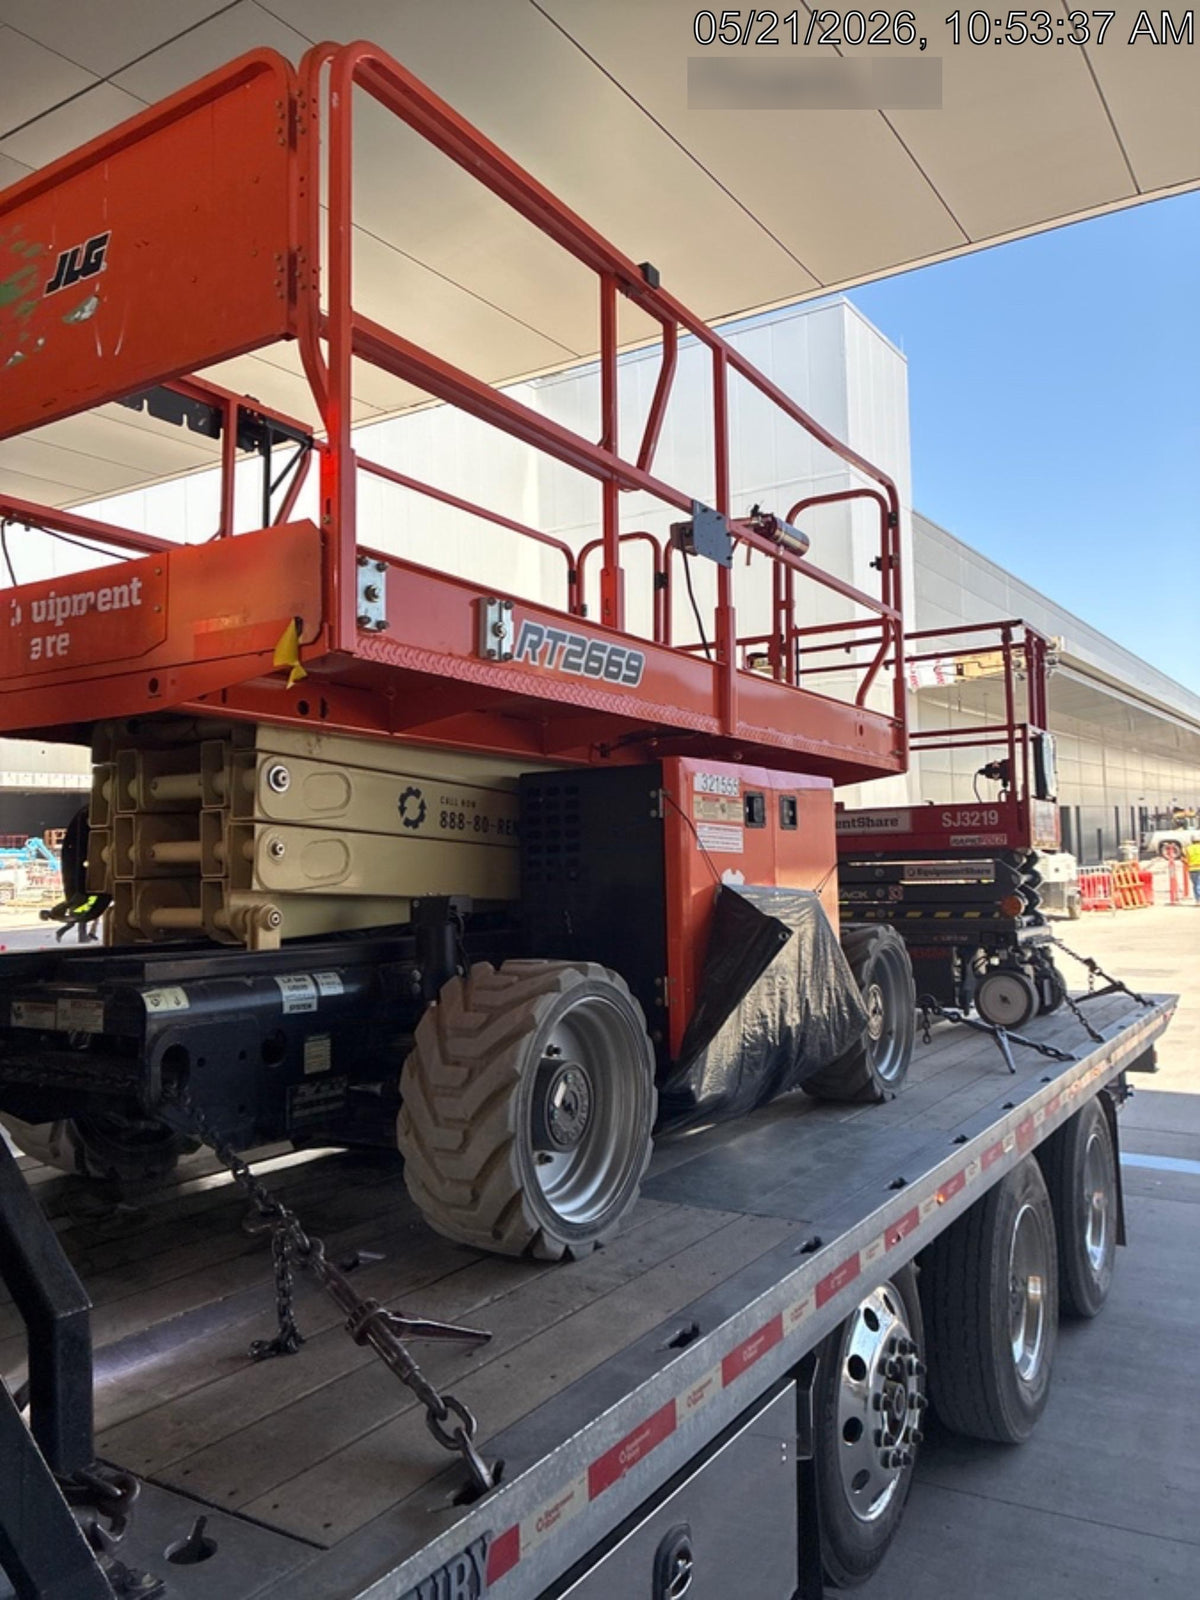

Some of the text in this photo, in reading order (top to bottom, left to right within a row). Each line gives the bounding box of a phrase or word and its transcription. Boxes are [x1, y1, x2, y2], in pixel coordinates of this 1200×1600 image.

[43, 229, 112, 298] JLG
[514, 619, 645, 689] RT2669
[942, 810, 998, 828] SJ3219
